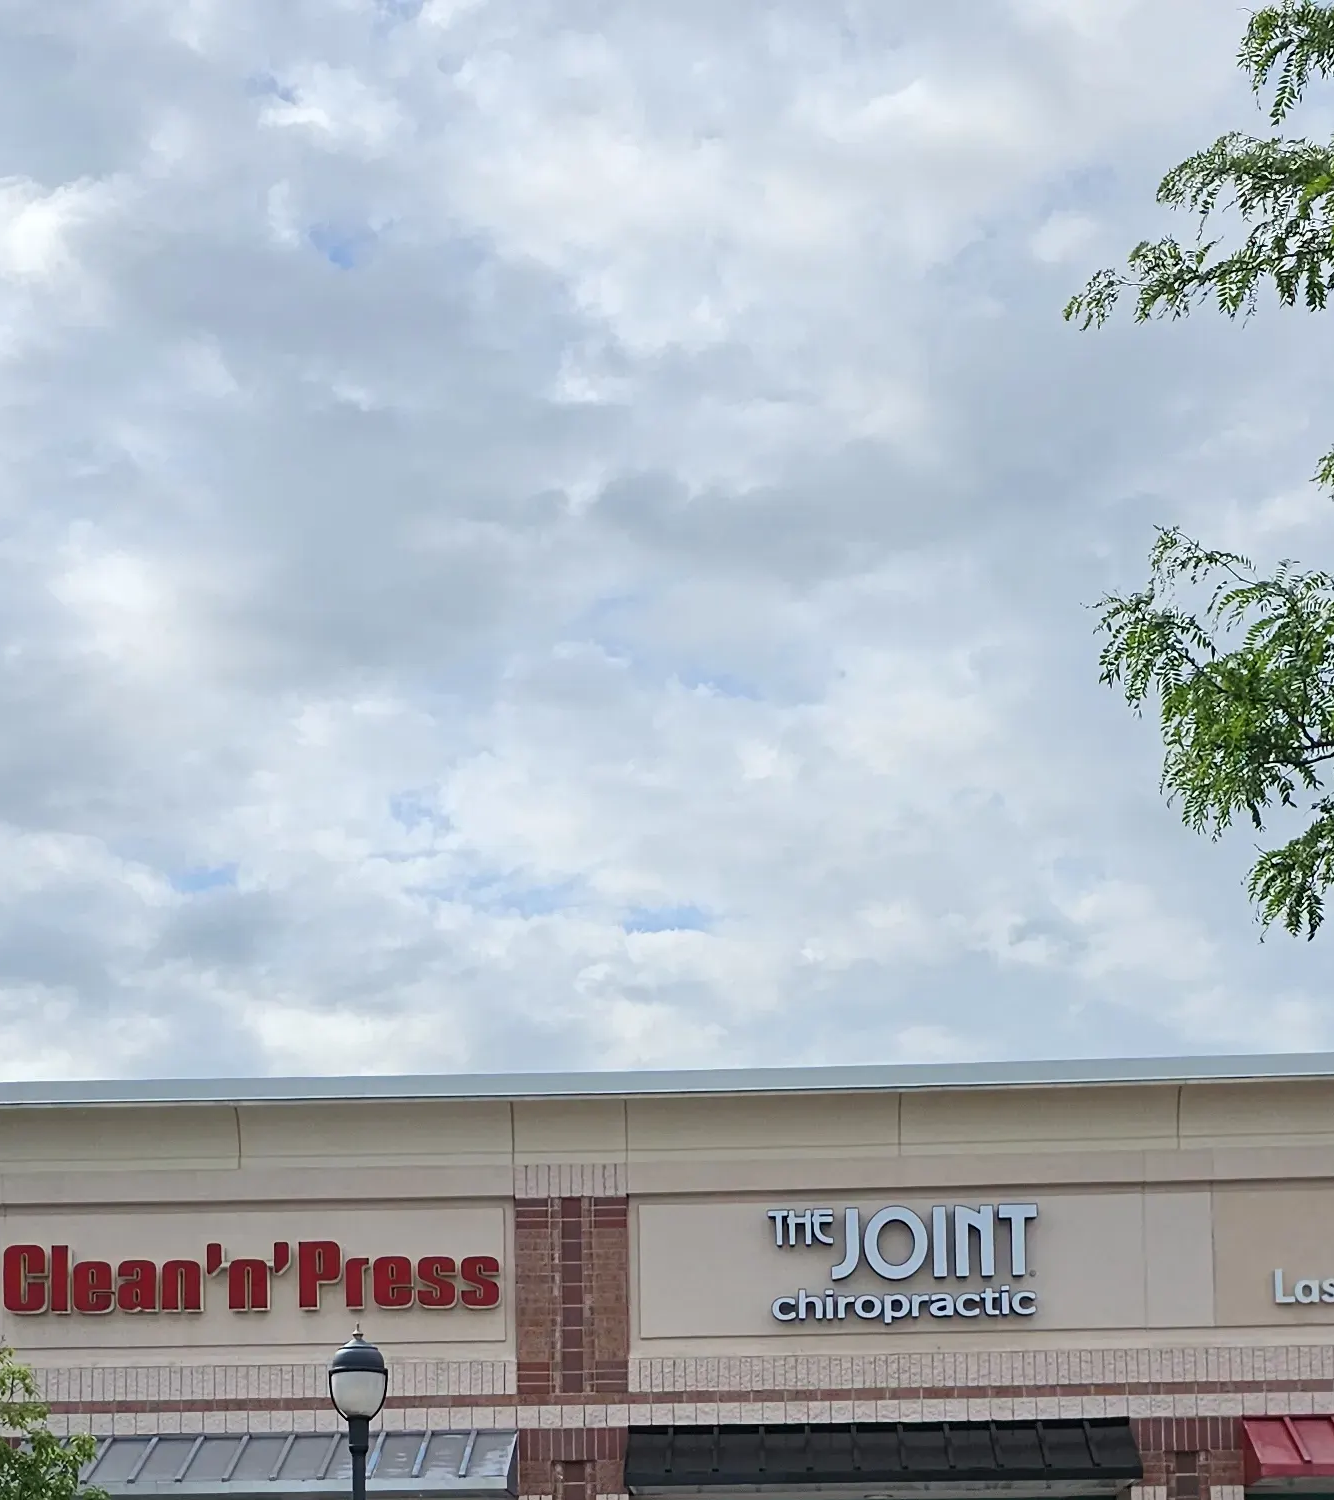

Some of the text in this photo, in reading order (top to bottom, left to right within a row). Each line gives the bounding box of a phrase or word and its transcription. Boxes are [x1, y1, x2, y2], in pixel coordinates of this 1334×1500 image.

[2, 1240, 501, 1314] Clean'n'Press
[767, 1203, 1038, 1281] THE JOINT
[770, 1284, 1038, 1324] chiropractic
